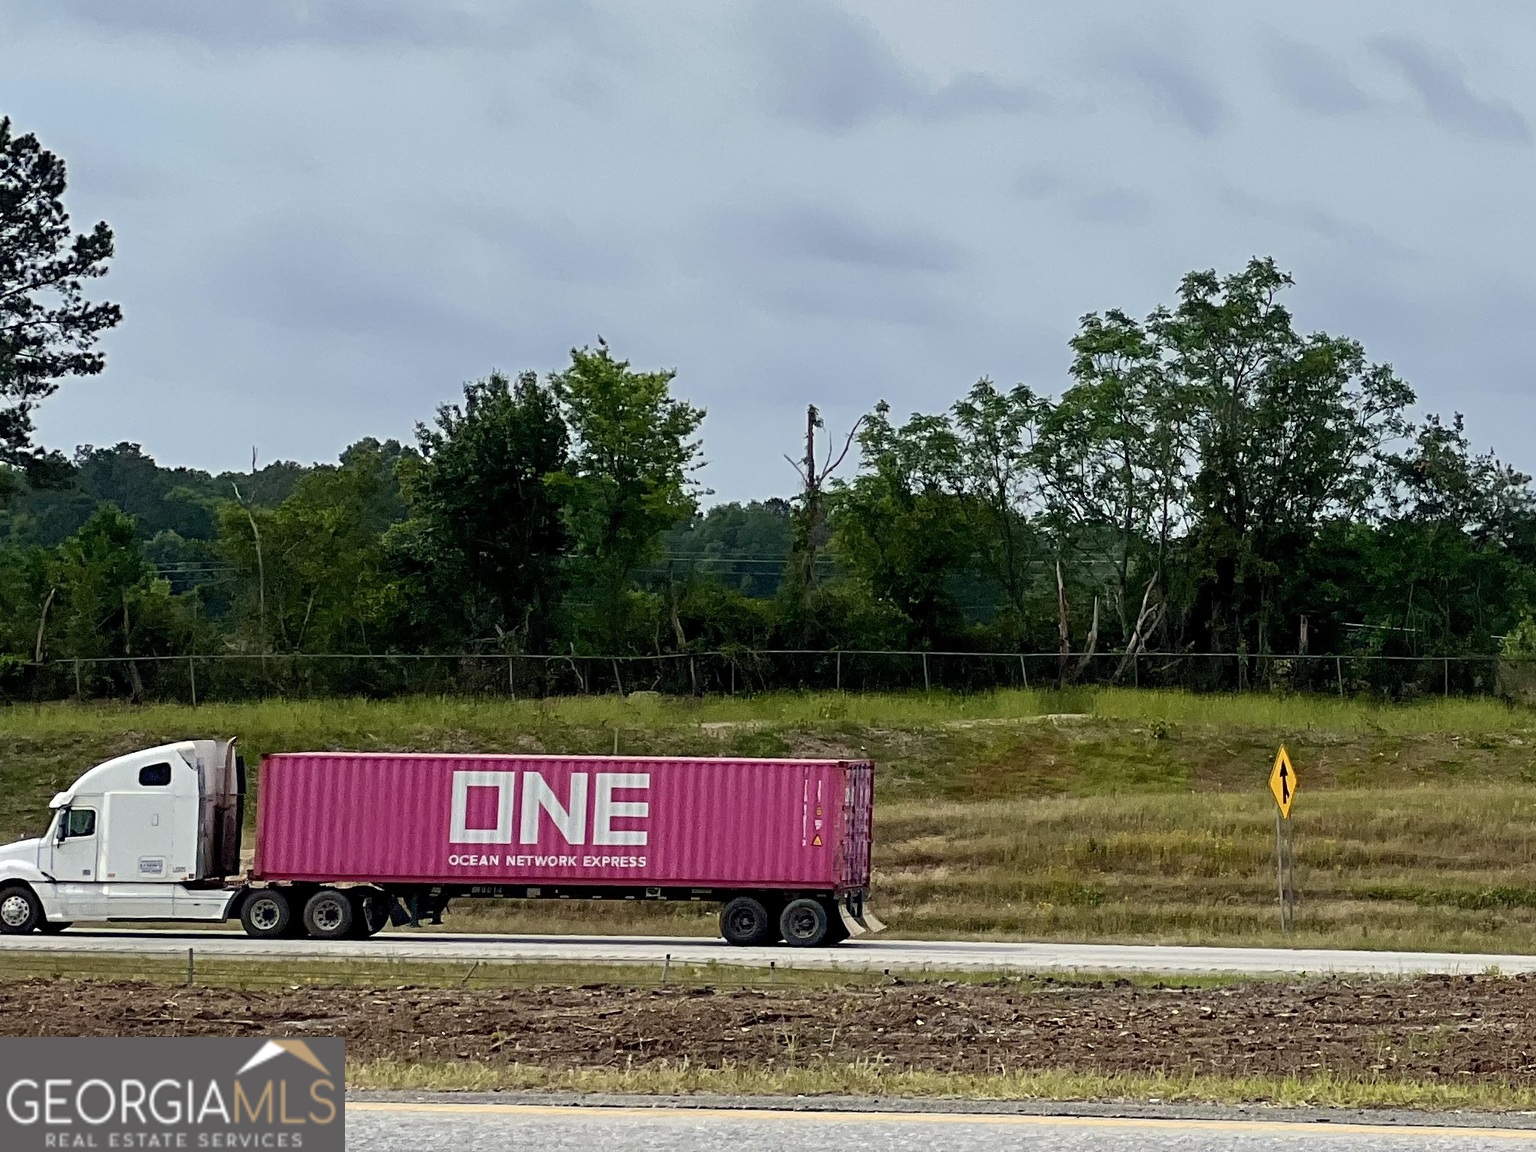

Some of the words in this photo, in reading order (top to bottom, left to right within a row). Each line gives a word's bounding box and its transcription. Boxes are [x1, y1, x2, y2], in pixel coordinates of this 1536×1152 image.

[449, 770, 650, 846] ONE
[448, 854, 499, 866] OCEAN
[506, 855, 577, 867] NETWORK
[583, 856, 647, 868] EXPRESS
